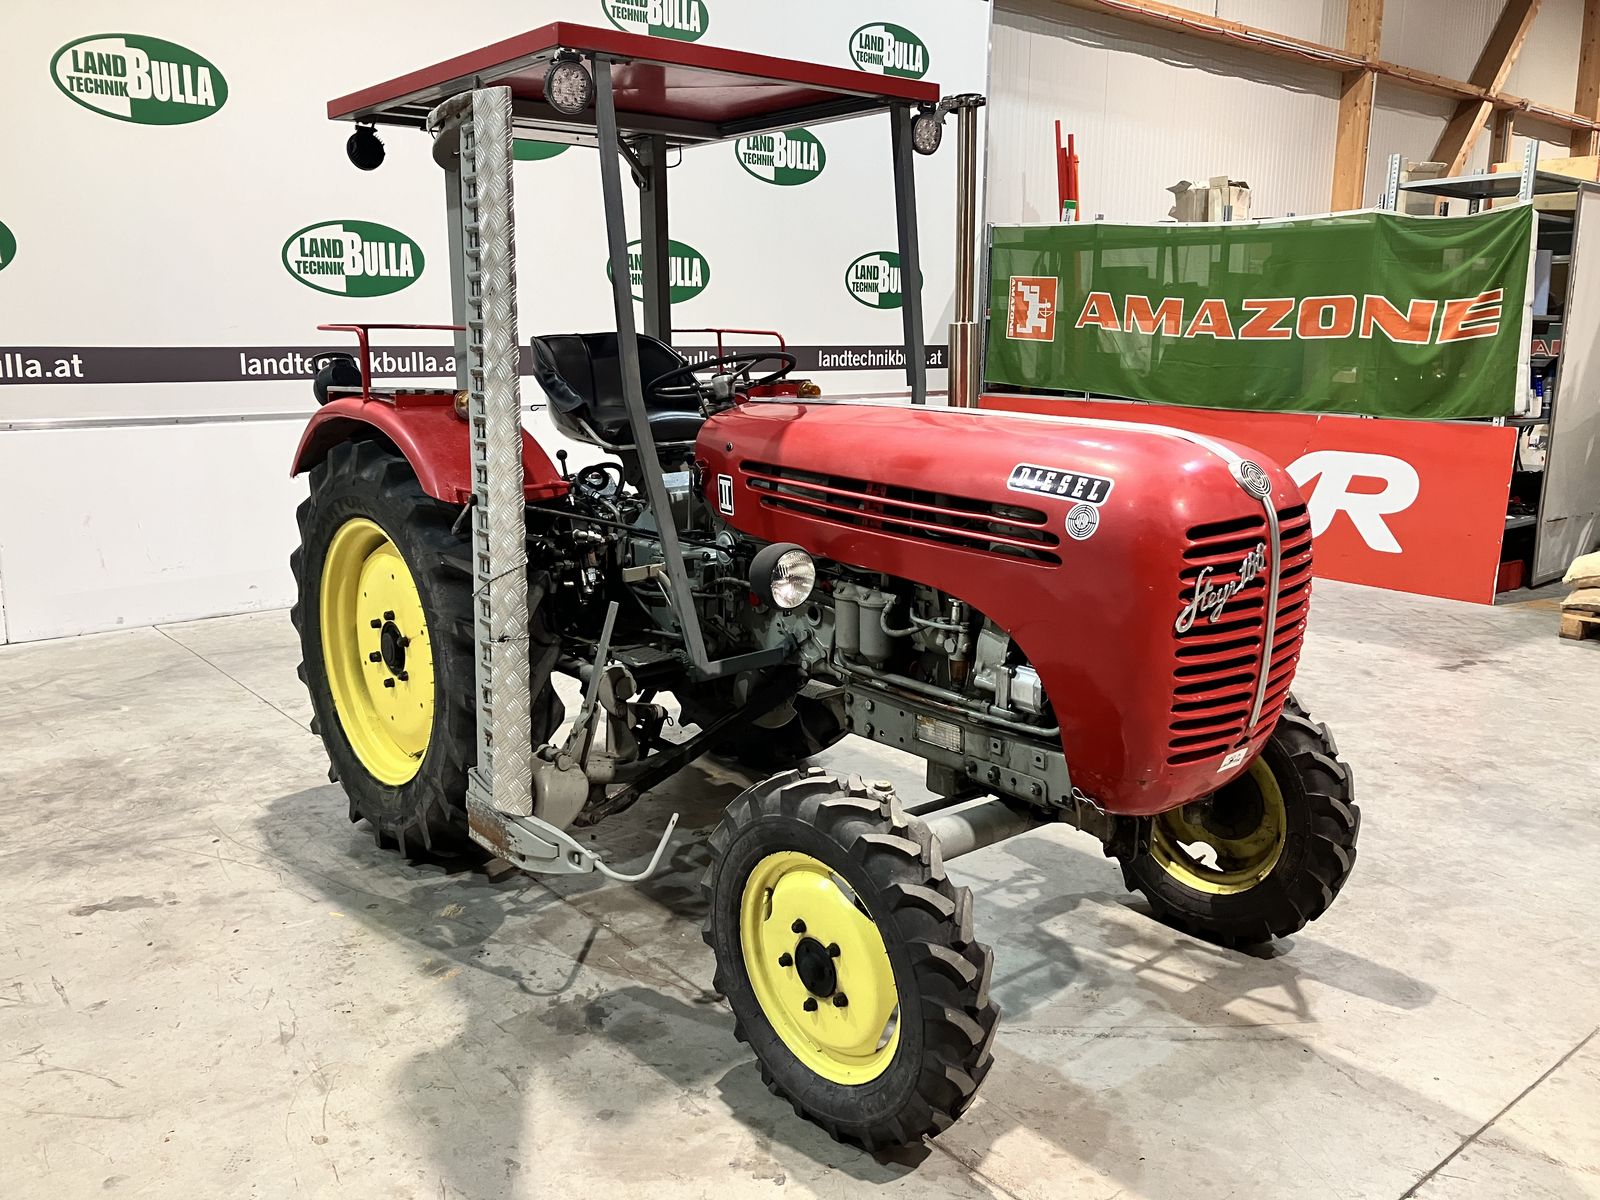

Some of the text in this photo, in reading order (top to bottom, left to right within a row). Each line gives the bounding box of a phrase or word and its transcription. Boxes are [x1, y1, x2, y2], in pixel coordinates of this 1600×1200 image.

[611, 5, 649, 24] TECHNIK
[647, 0, 701, 33] BULLA
[859, 33, 884, 52] LAND
[883, 31, 924, 73] BULLA
[71, 49, 127, 78] LAND
[856, 50, 884, 66] TECHNIK
[66, 75, 130, 98] TECHNIK
[128, 47, 217, 107] BULLA
[746, 135, 775, 153] LAND
[774, 131, 819, 171] BULLA
[743, 152, 775, 167] TECHNIK
[299, 237, 344, 259] LAND
[344, 231, 415, 278] BULLA
[295, 260, 346, 276] TECHNIK
[669, 256, 703, 287] ULLA
[855, 264, 879, 280] LAND
[852, 281, 879, 293] TECHNIK
[1008, 279, 1016, 337] AMAZONE
[1074, 288, 1504, 345] AMAZONE
[1016, 467, 1102, 501] DIESEL
[1175, 566, 1243, 633] Steyr
